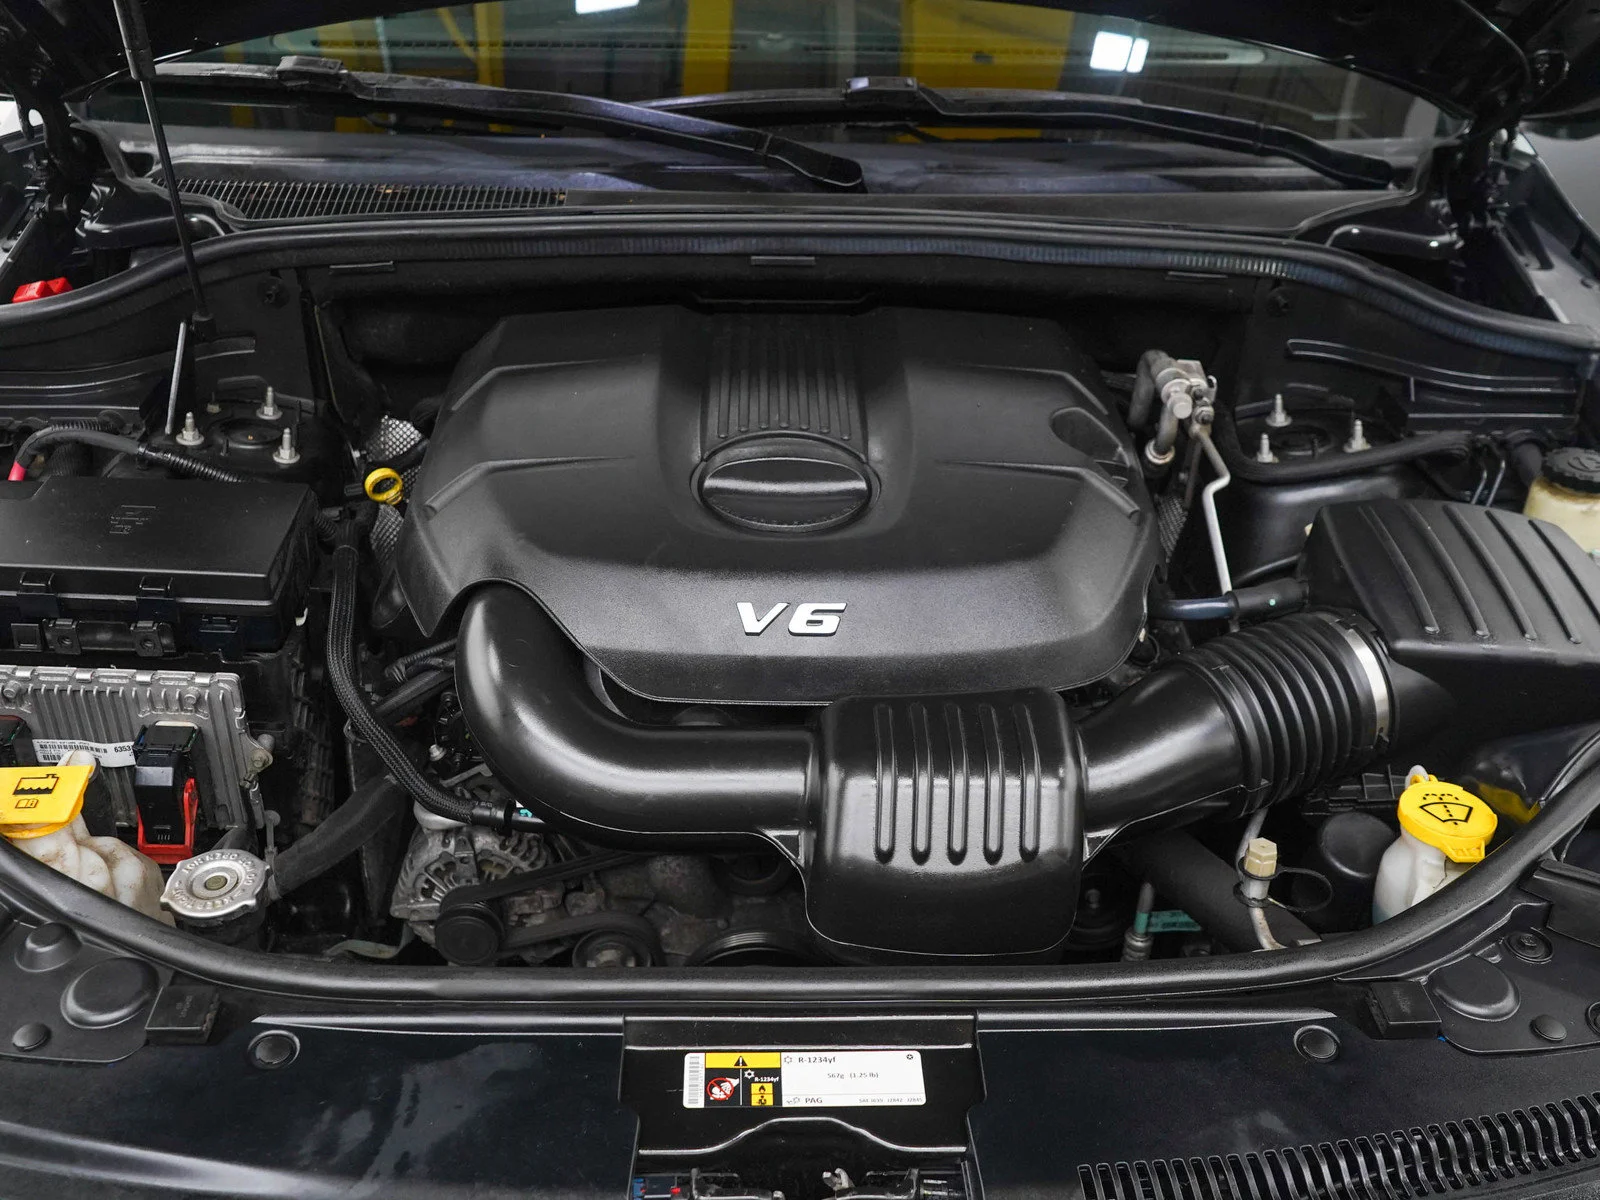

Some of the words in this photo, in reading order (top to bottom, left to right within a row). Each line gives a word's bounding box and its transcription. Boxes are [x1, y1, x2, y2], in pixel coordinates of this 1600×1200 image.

[736, 602, 847, 636] V6
[798, 1056, 836, 1064] R-1234yf
[827, 1072, 845, 1080] 567g
